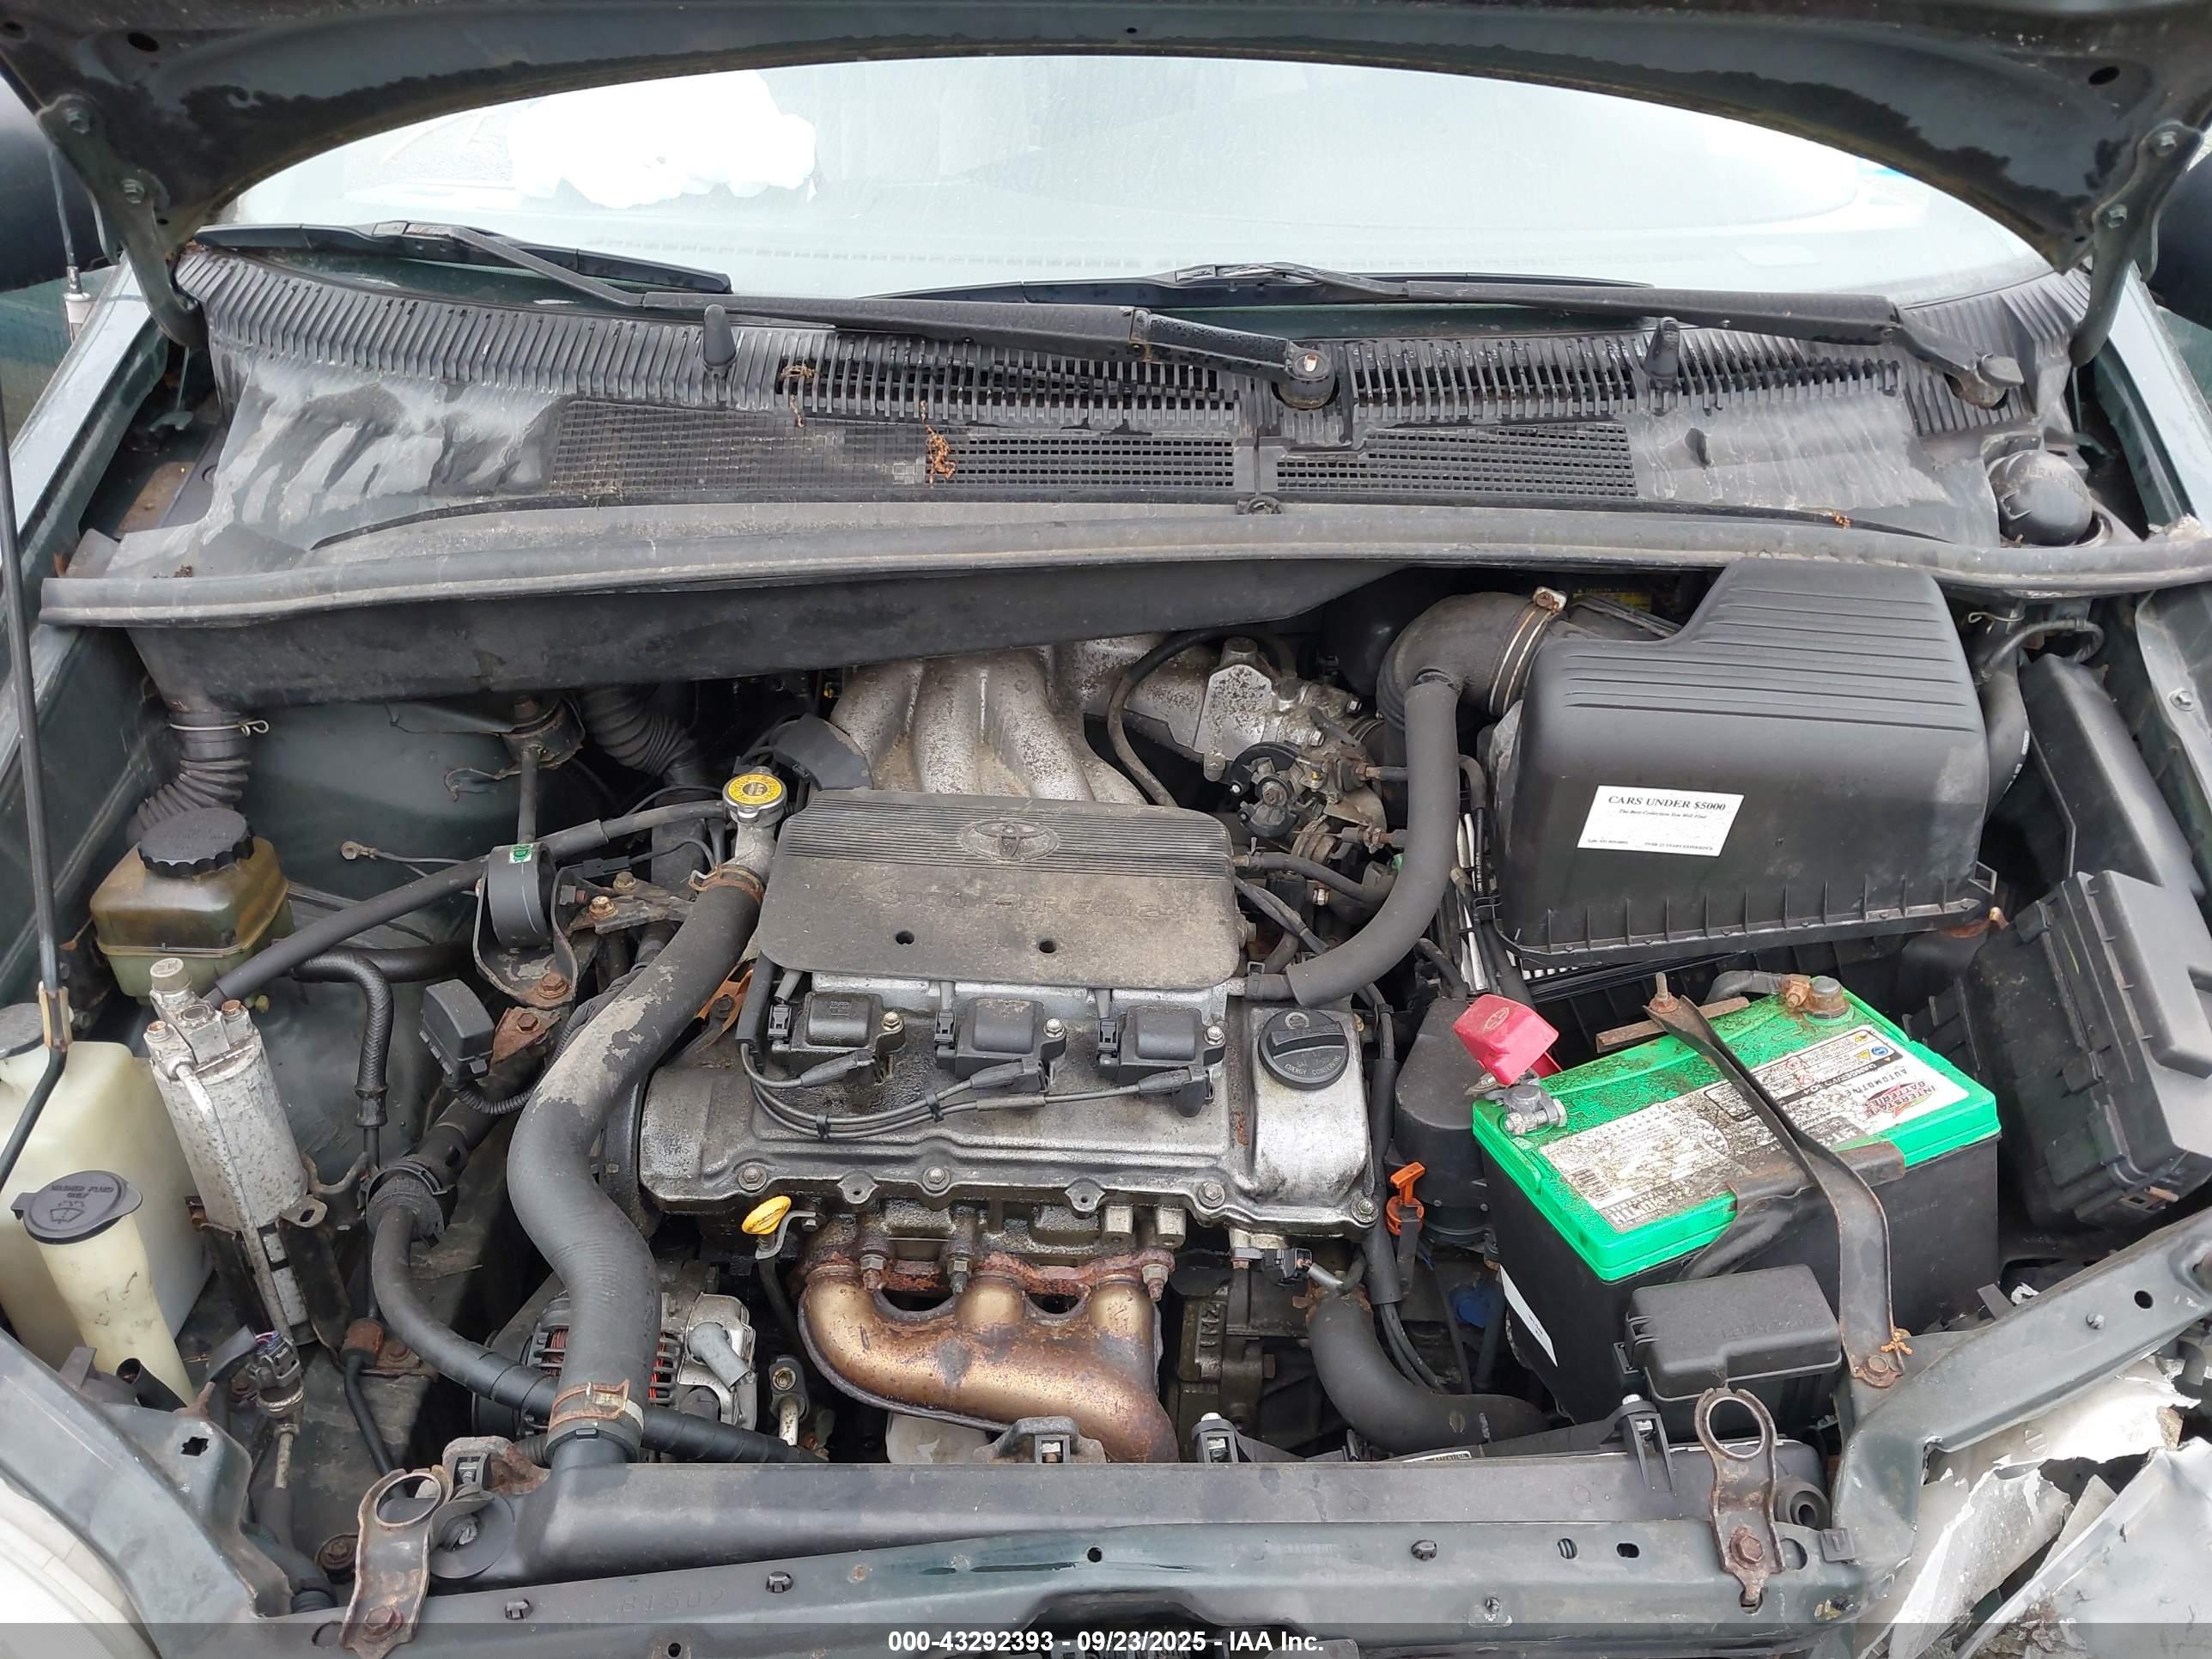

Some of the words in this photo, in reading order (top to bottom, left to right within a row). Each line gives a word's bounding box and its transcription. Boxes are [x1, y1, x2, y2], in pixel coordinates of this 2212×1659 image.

[1608, 795, 1644, 805] CARS
[1646, 797, 1691, 809] UNDER
[1693, 800, 1726, 811] $5000
[1864, 1081, 1926, 1109] BATTERIES
[1866, 1085, 1936, 1116] INTERSTATE
